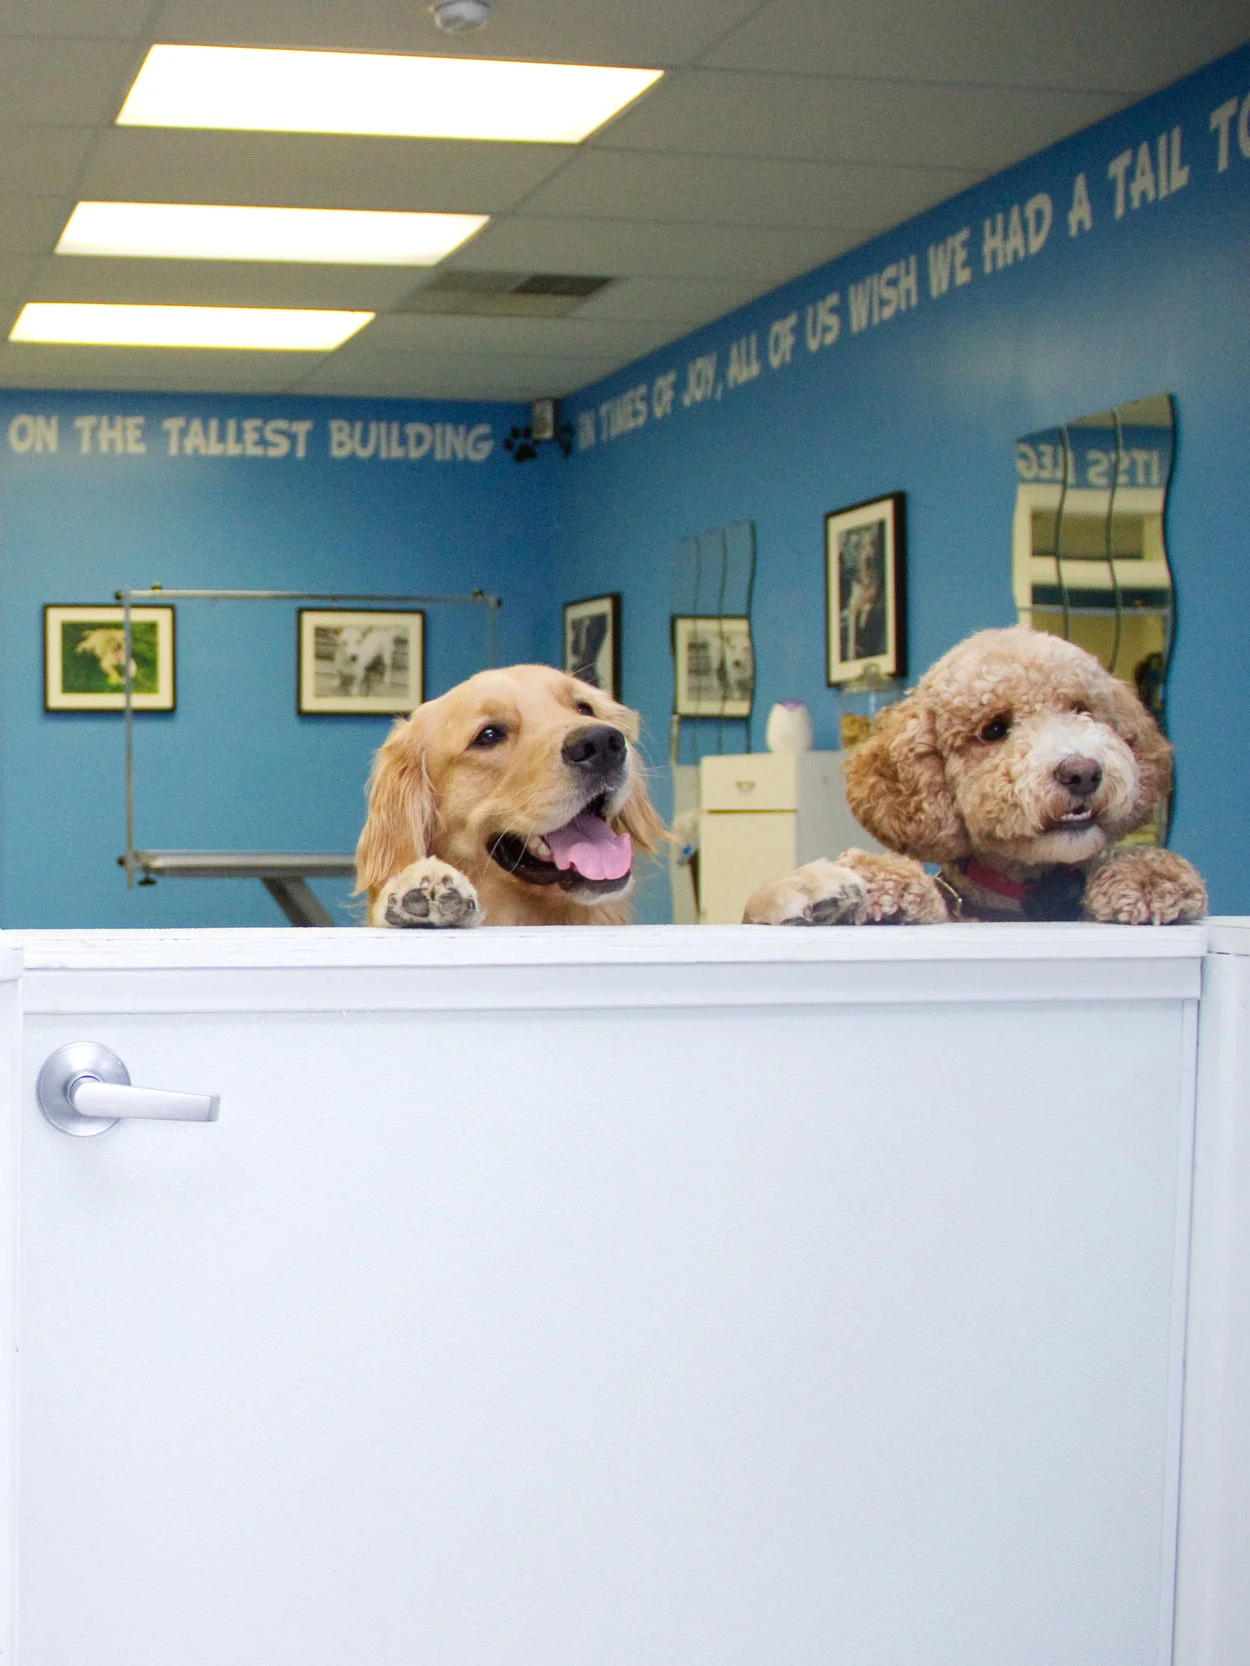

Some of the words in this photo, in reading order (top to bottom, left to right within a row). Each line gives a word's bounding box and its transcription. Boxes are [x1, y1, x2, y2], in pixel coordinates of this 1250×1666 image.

[653, 370, 677, 419] OF
[726, 332, 761, 389] ALL
[768, 312, 798, 370] OF
[806, 292, 841, 352] US
[848, 254, 918, 334] WISH
[927, 226, 972, 299] WE
[983, 192, 1052, 275] HAD
[1068, 172, 1093, 238] A
[1107, 125, 1190, 220] TAIL
[8, 413, 59, 454] ON
[75, 415, 147, 454] THE
[161, 416, 314, 458] TALLEST
[328, 418, 494, 463] BUILDING
